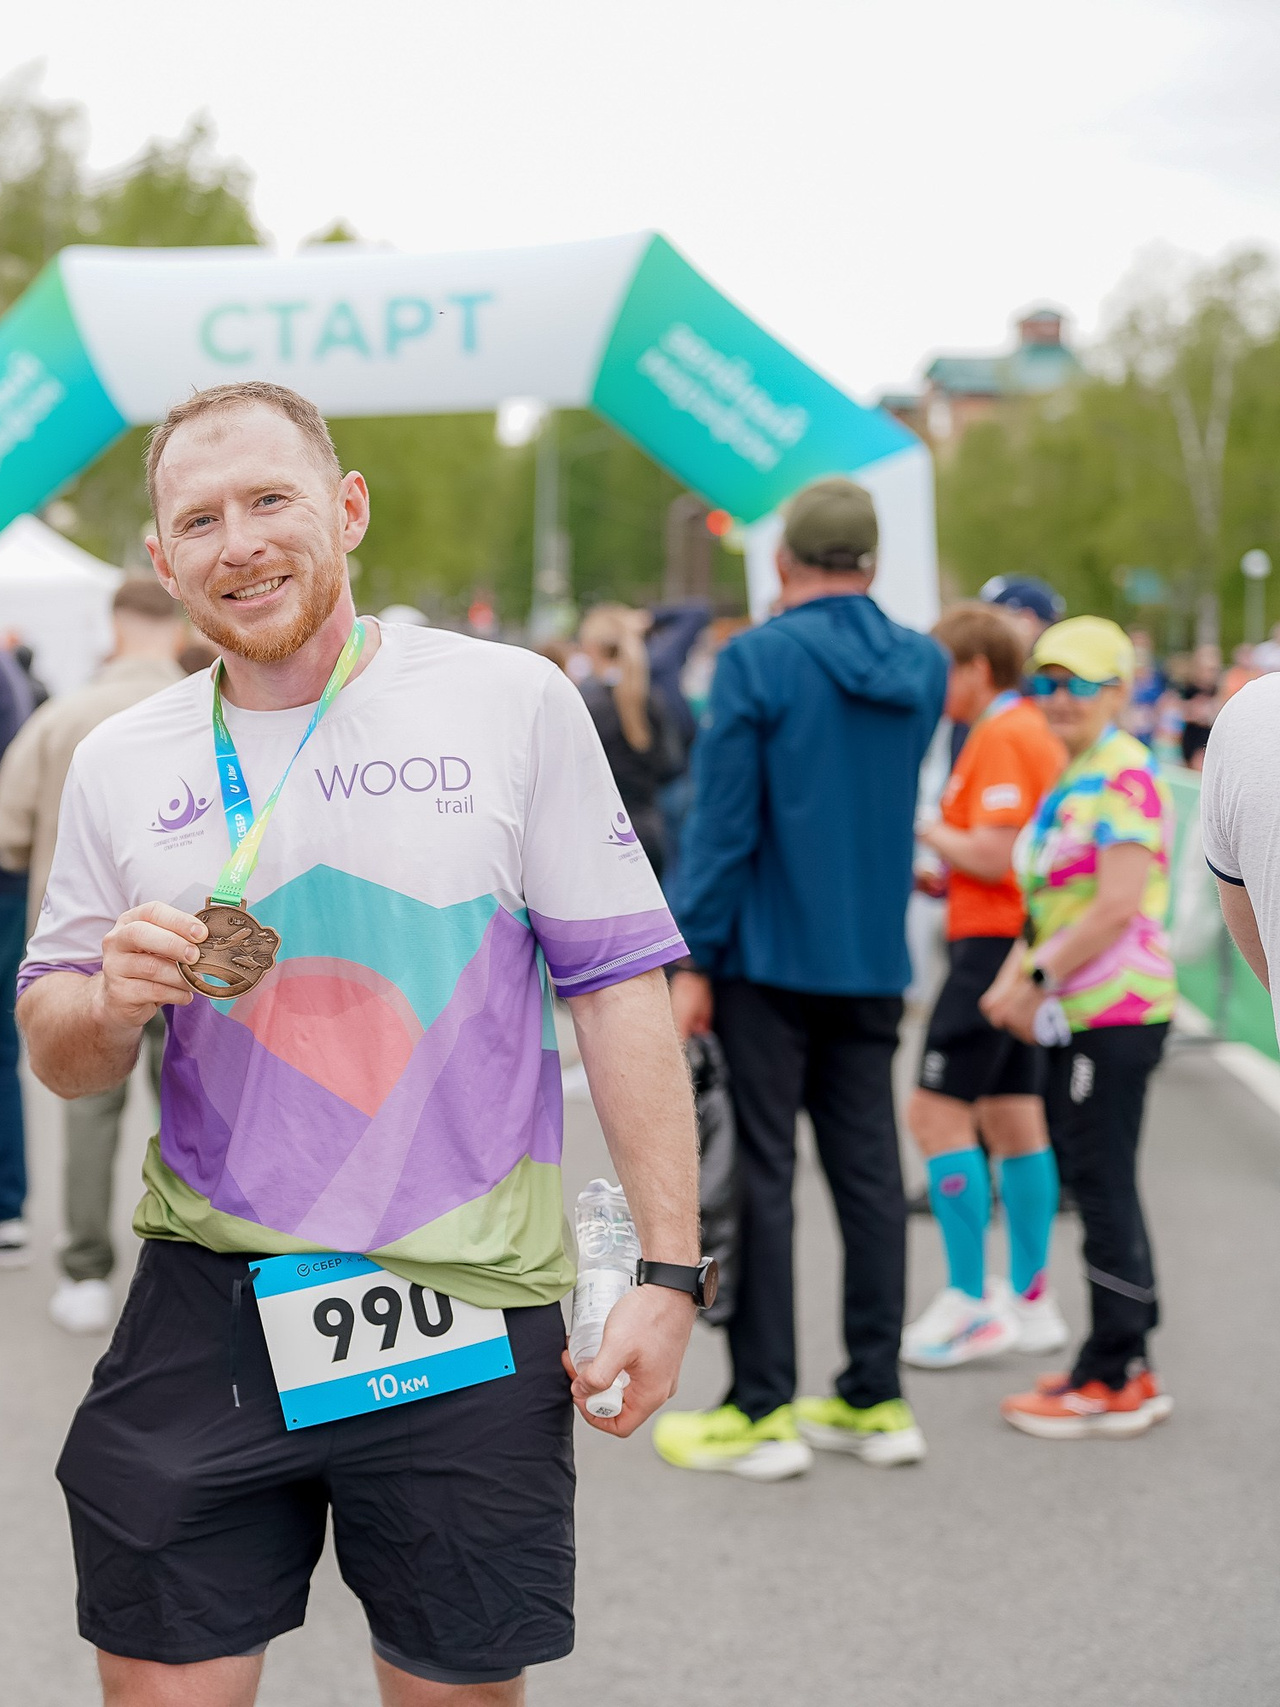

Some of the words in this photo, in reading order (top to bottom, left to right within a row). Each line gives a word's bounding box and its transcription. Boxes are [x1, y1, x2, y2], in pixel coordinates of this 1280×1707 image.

[198, 294, 494, 366] СТАРТ
[228, 764, 238, 781] Utair
[314, 756, 472, 801] WOOD
[435, 794, 474, 814] trail
[234, 813, 247, 838] СБЕР
[312, 1257, 342, 1272] СБЕР
[312, 1281, 454, 1363] 990
